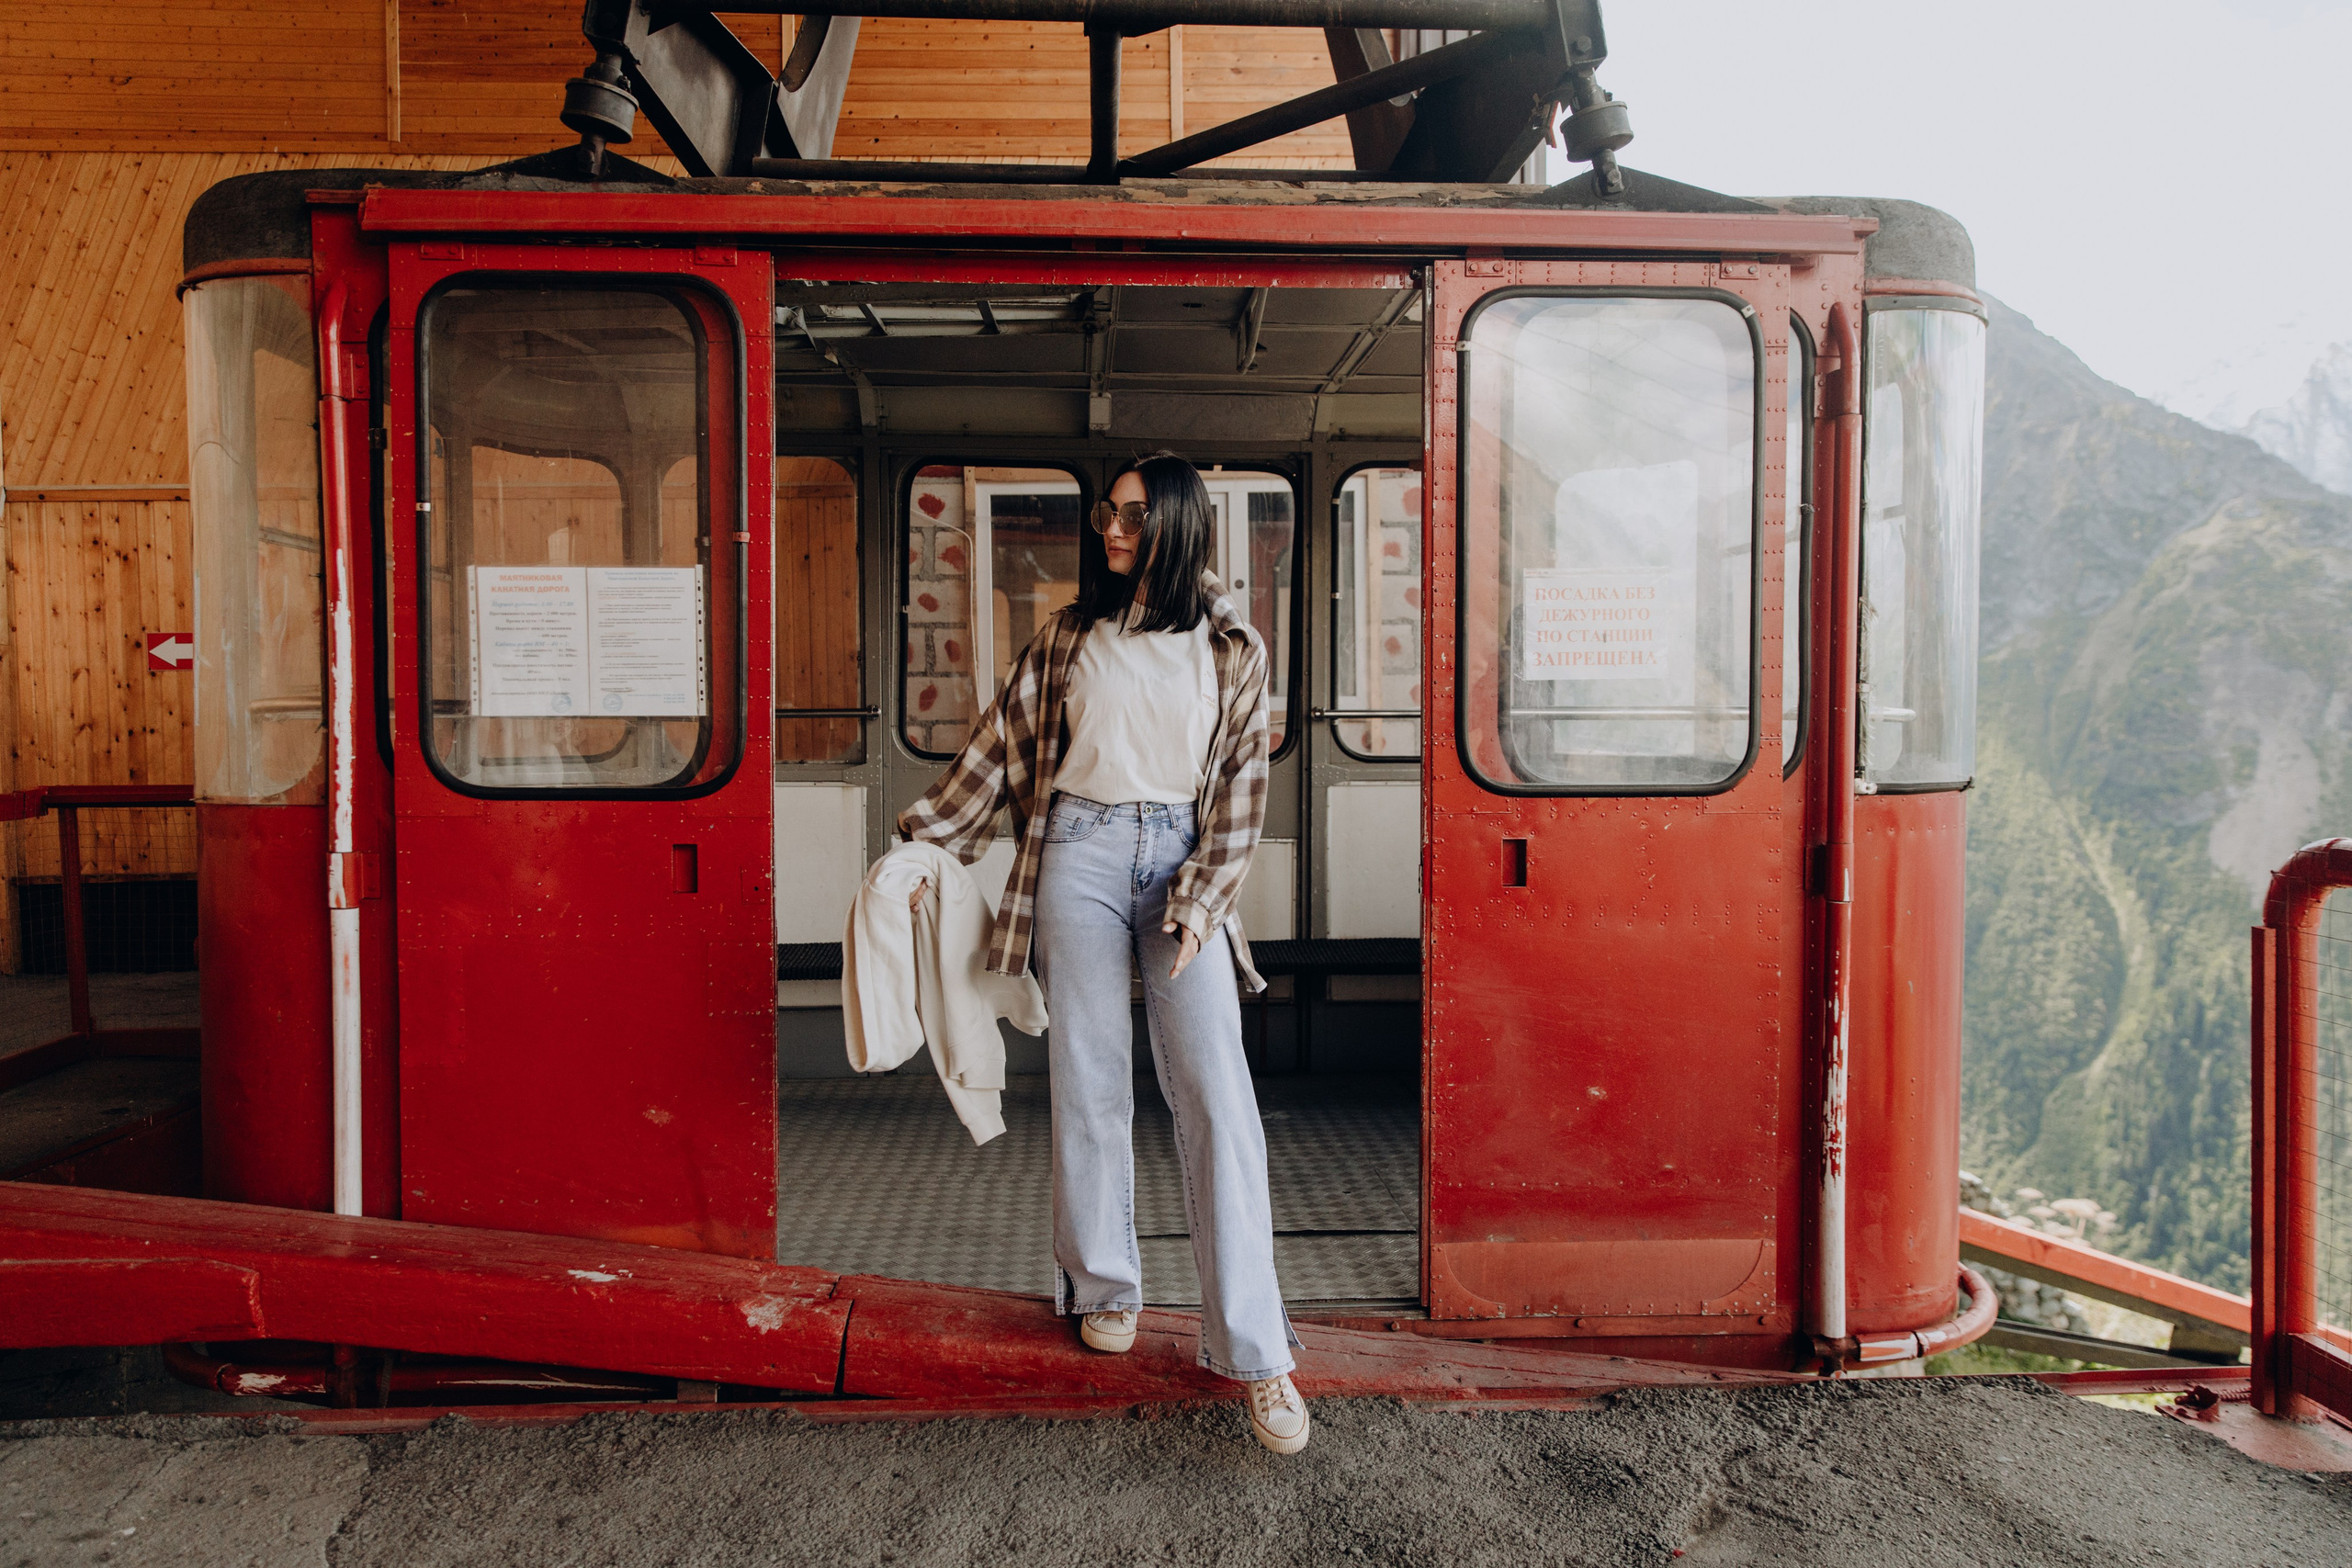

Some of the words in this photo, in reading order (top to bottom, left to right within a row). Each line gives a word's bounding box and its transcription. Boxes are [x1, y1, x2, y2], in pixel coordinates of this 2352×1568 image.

[1534, 588, 1620, 602] ПОСАДКА
[1625, 587, 1656, 600] БЕЗ
[1539, 607, 1650, 623] ДЕЖУРНОГО
[1536, 630, 1562, 643] ПО
[1566, 628, 1653, 643] СТАНЦИИ
[1532, 650, 1657, 668] ЗАПРЕЩЕНА
